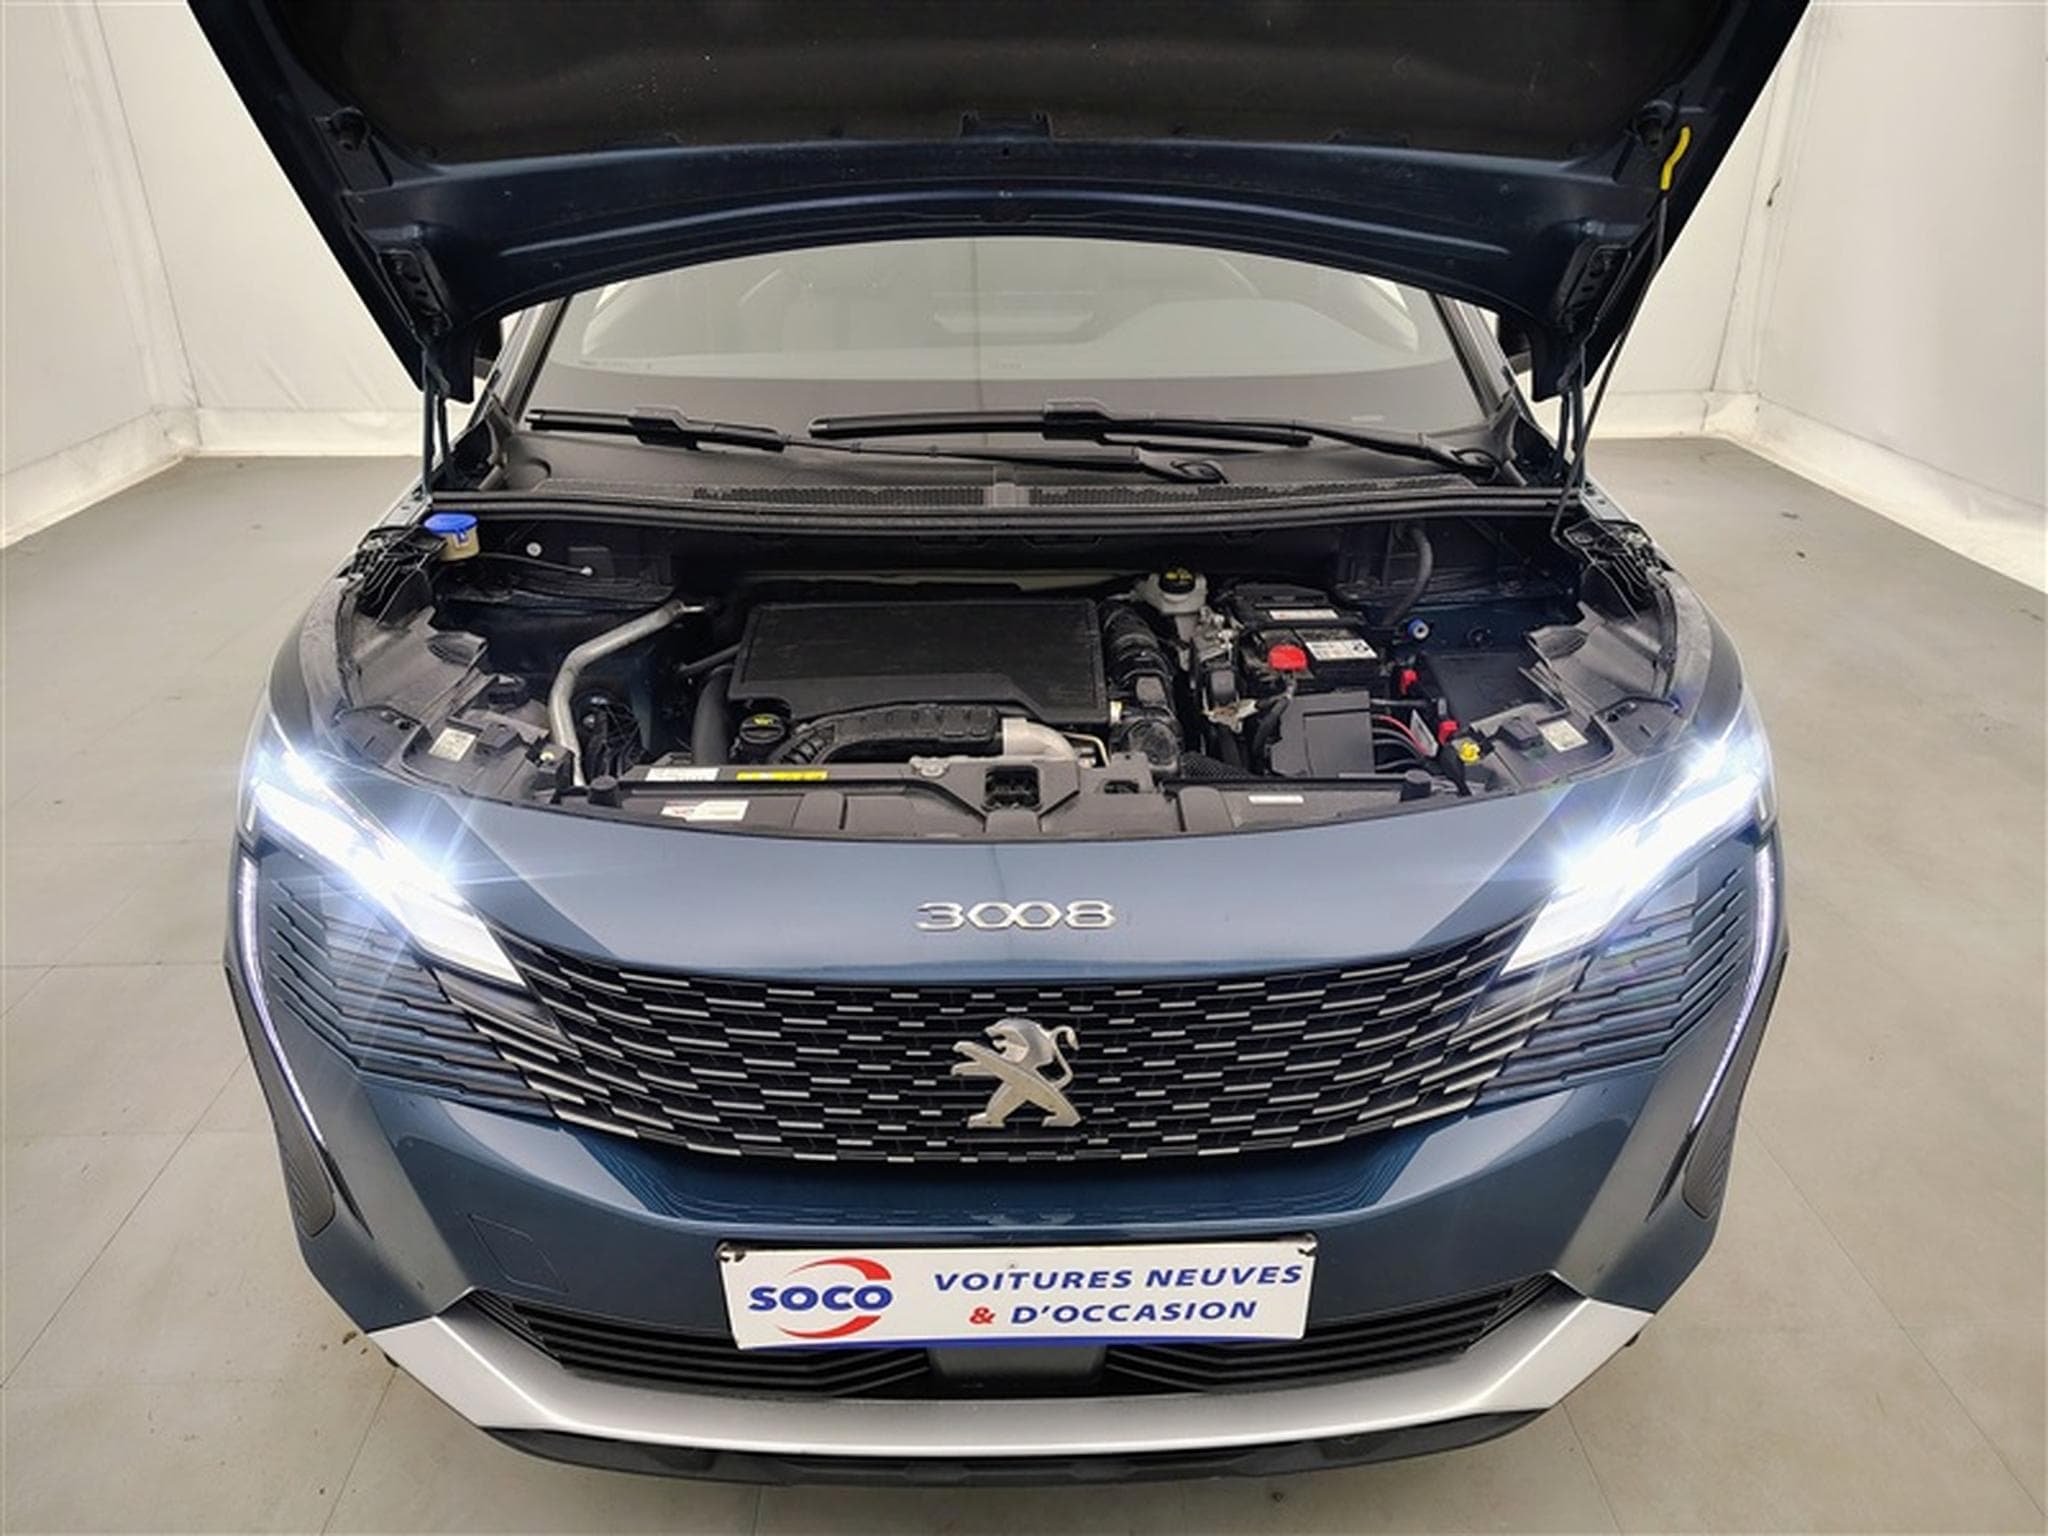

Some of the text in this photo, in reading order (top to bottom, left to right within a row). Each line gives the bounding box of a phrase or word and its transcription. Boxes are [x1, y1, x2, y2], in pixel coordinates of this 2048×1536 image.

[915, 900, 1116, 931] 3008
[935, 1265, 1303, 1291] VOITURES NEUVES
[748, 1285, 893, 1312] SOCO
[969, 1301, 1257, 1325] & D'OCCASION
